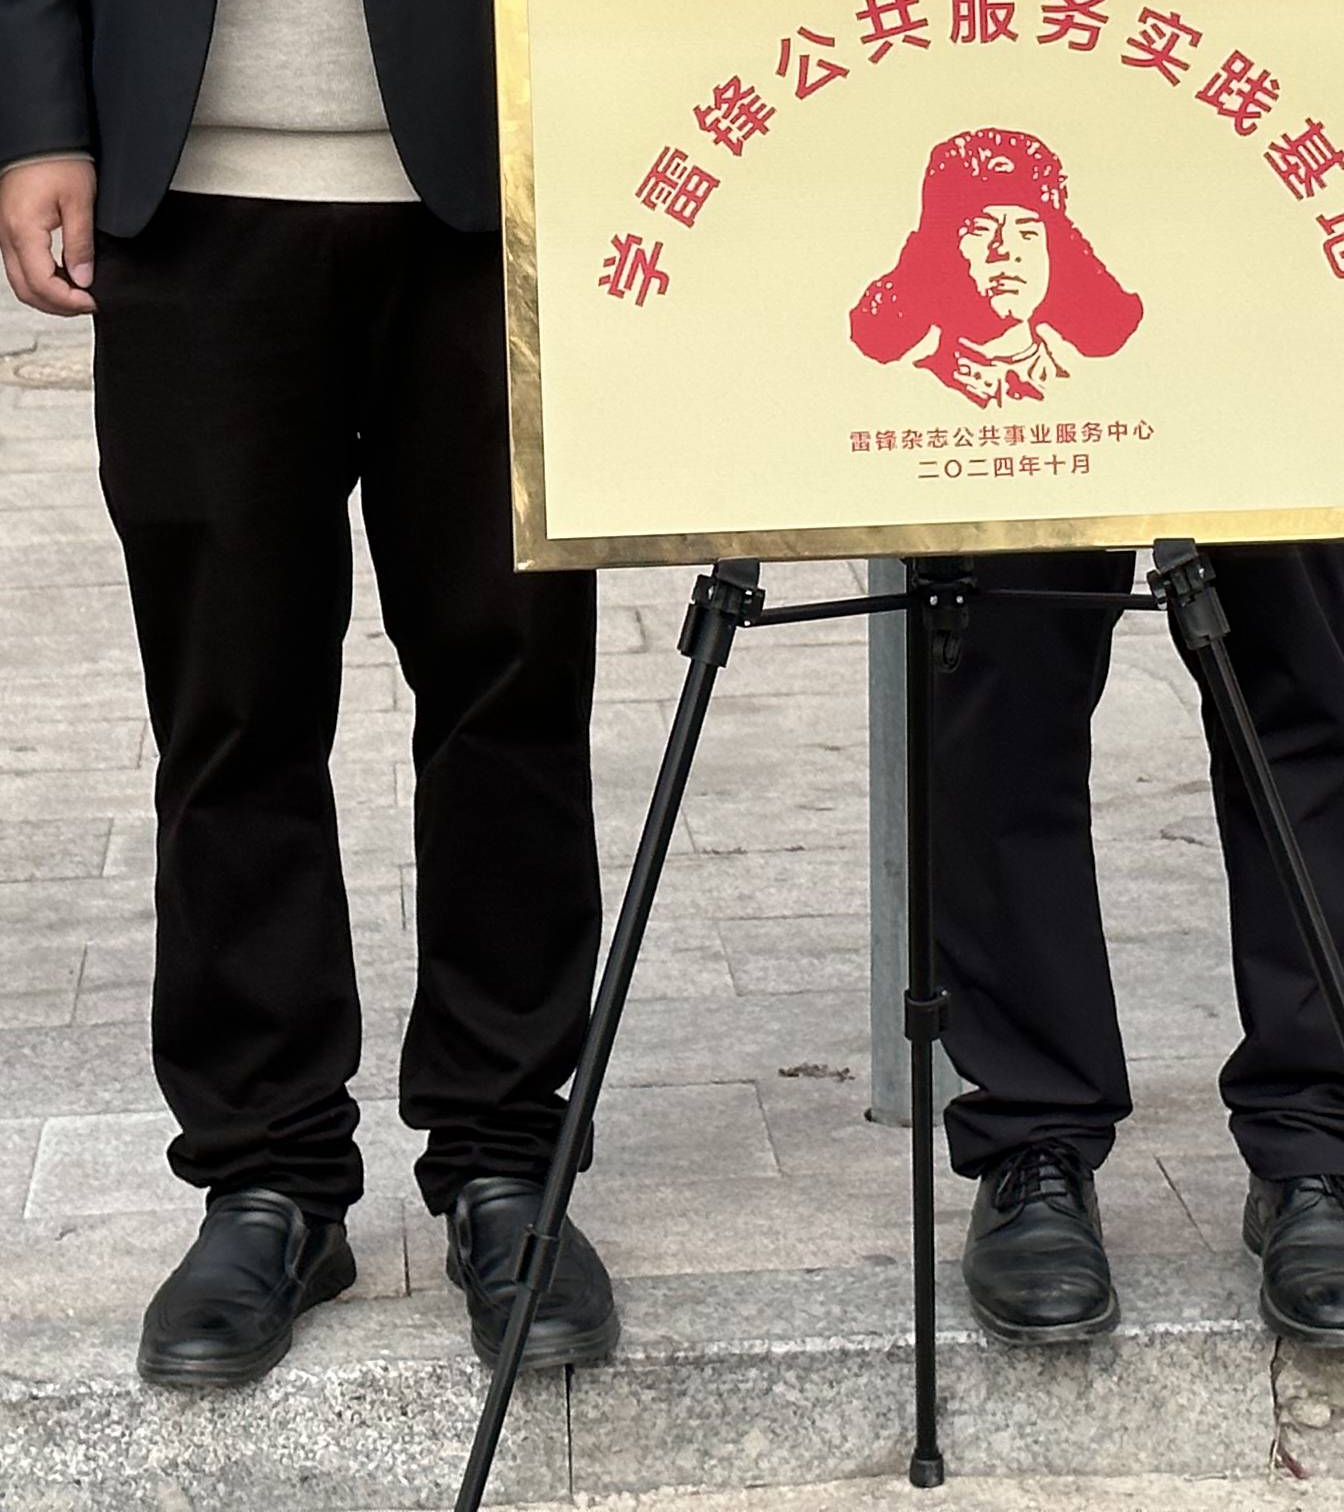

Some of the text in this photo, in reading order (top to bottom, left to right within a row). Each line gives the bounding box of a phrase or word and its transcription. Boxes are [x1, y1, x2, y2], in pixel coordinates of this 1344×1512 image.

[849, 419, 1154, 453] 雷锋杂志公共事业服务中心
